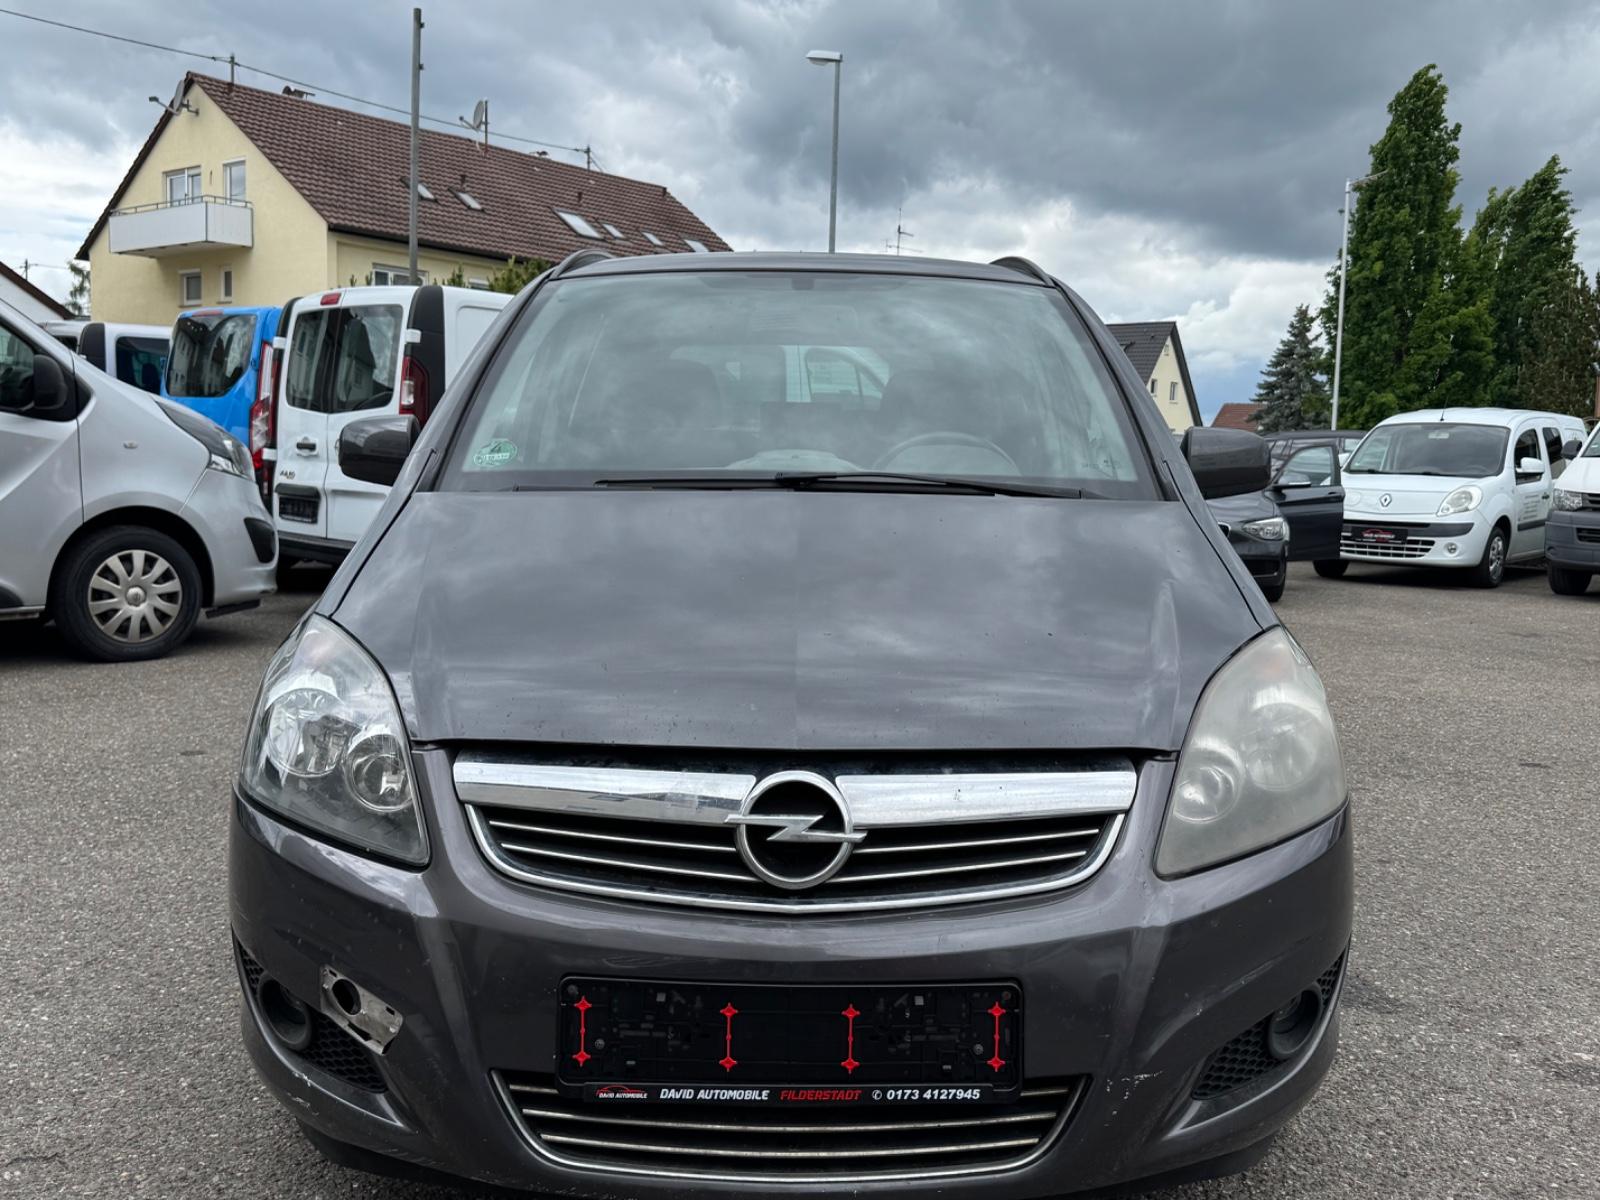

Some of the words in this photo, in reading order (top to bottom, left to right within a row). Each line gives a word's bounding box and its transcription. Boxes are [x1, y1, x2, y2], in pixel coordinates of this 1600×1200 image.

[659, 1088, 695, 1099] DAVID
[697, 1089, 770, 1100] AUTOMOBILE
[779, 1089, 862, 1101] FILDERSTADT
[886, 1089, 920, 1100] 0173
[922, 1088, 981, 1100] 4127945
